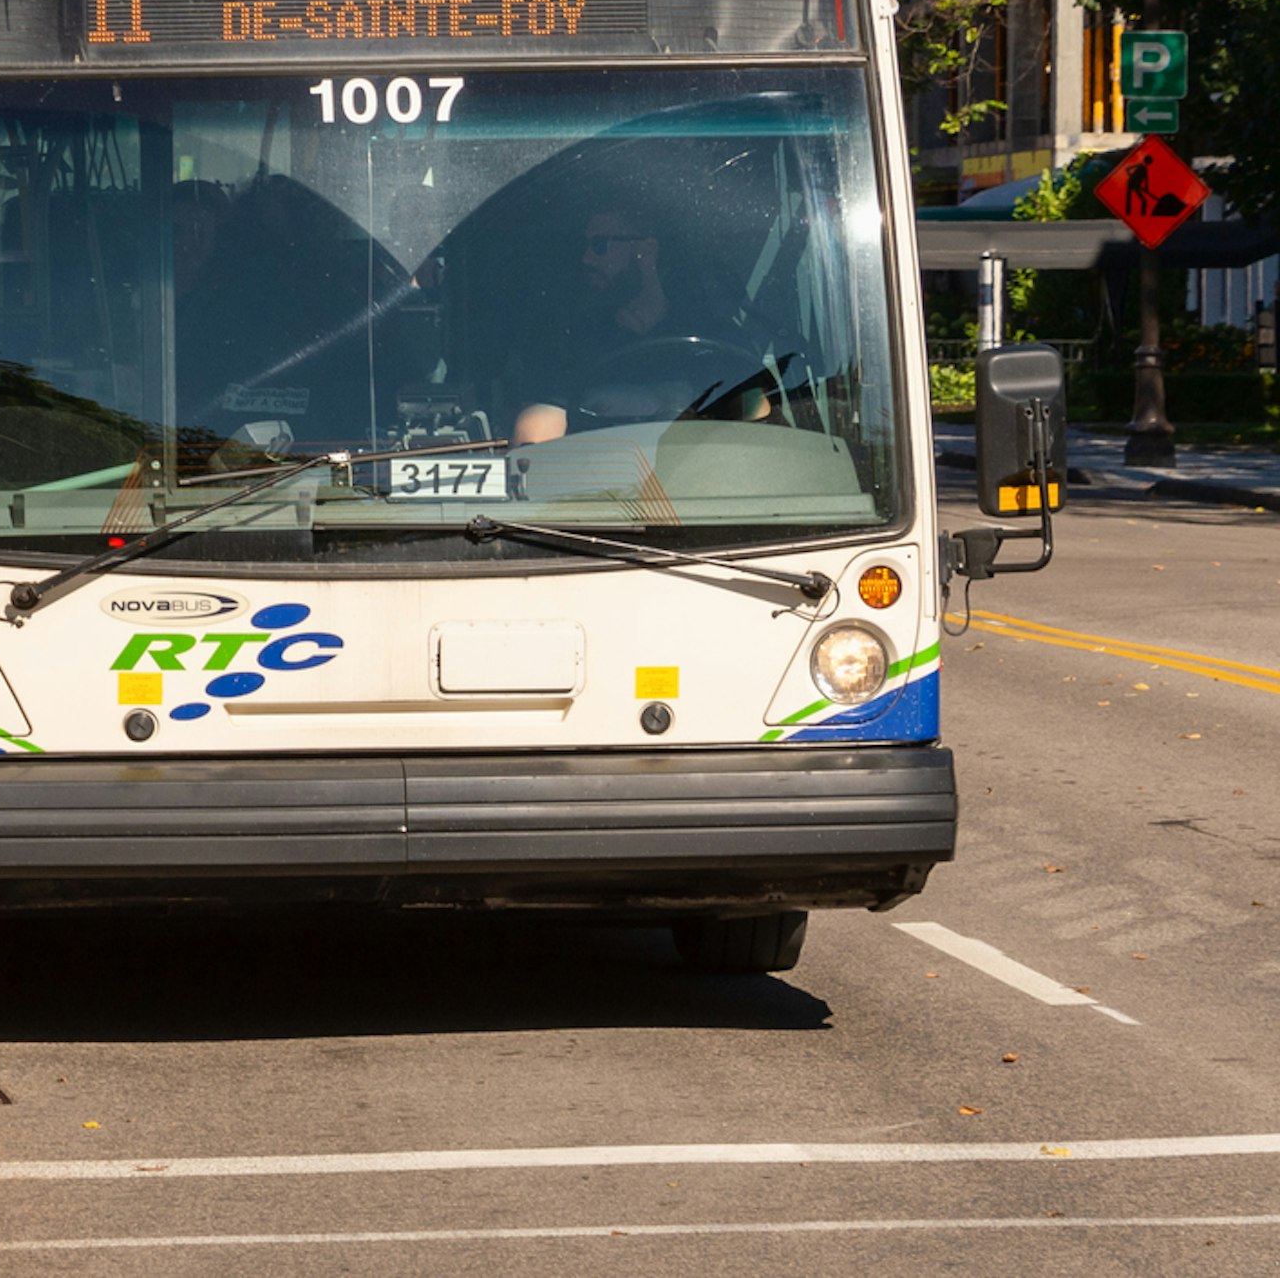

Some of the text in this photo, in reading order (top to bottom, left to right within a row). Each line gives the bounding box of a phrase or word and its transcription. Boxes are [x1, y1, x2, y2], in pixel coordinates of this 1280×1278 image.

[1132, 41, 1171, 88] P
[309, 76, 465, 124] 1007
[400, 463, 493, 494] 3177
[109, 632, 345, 671] RTC
